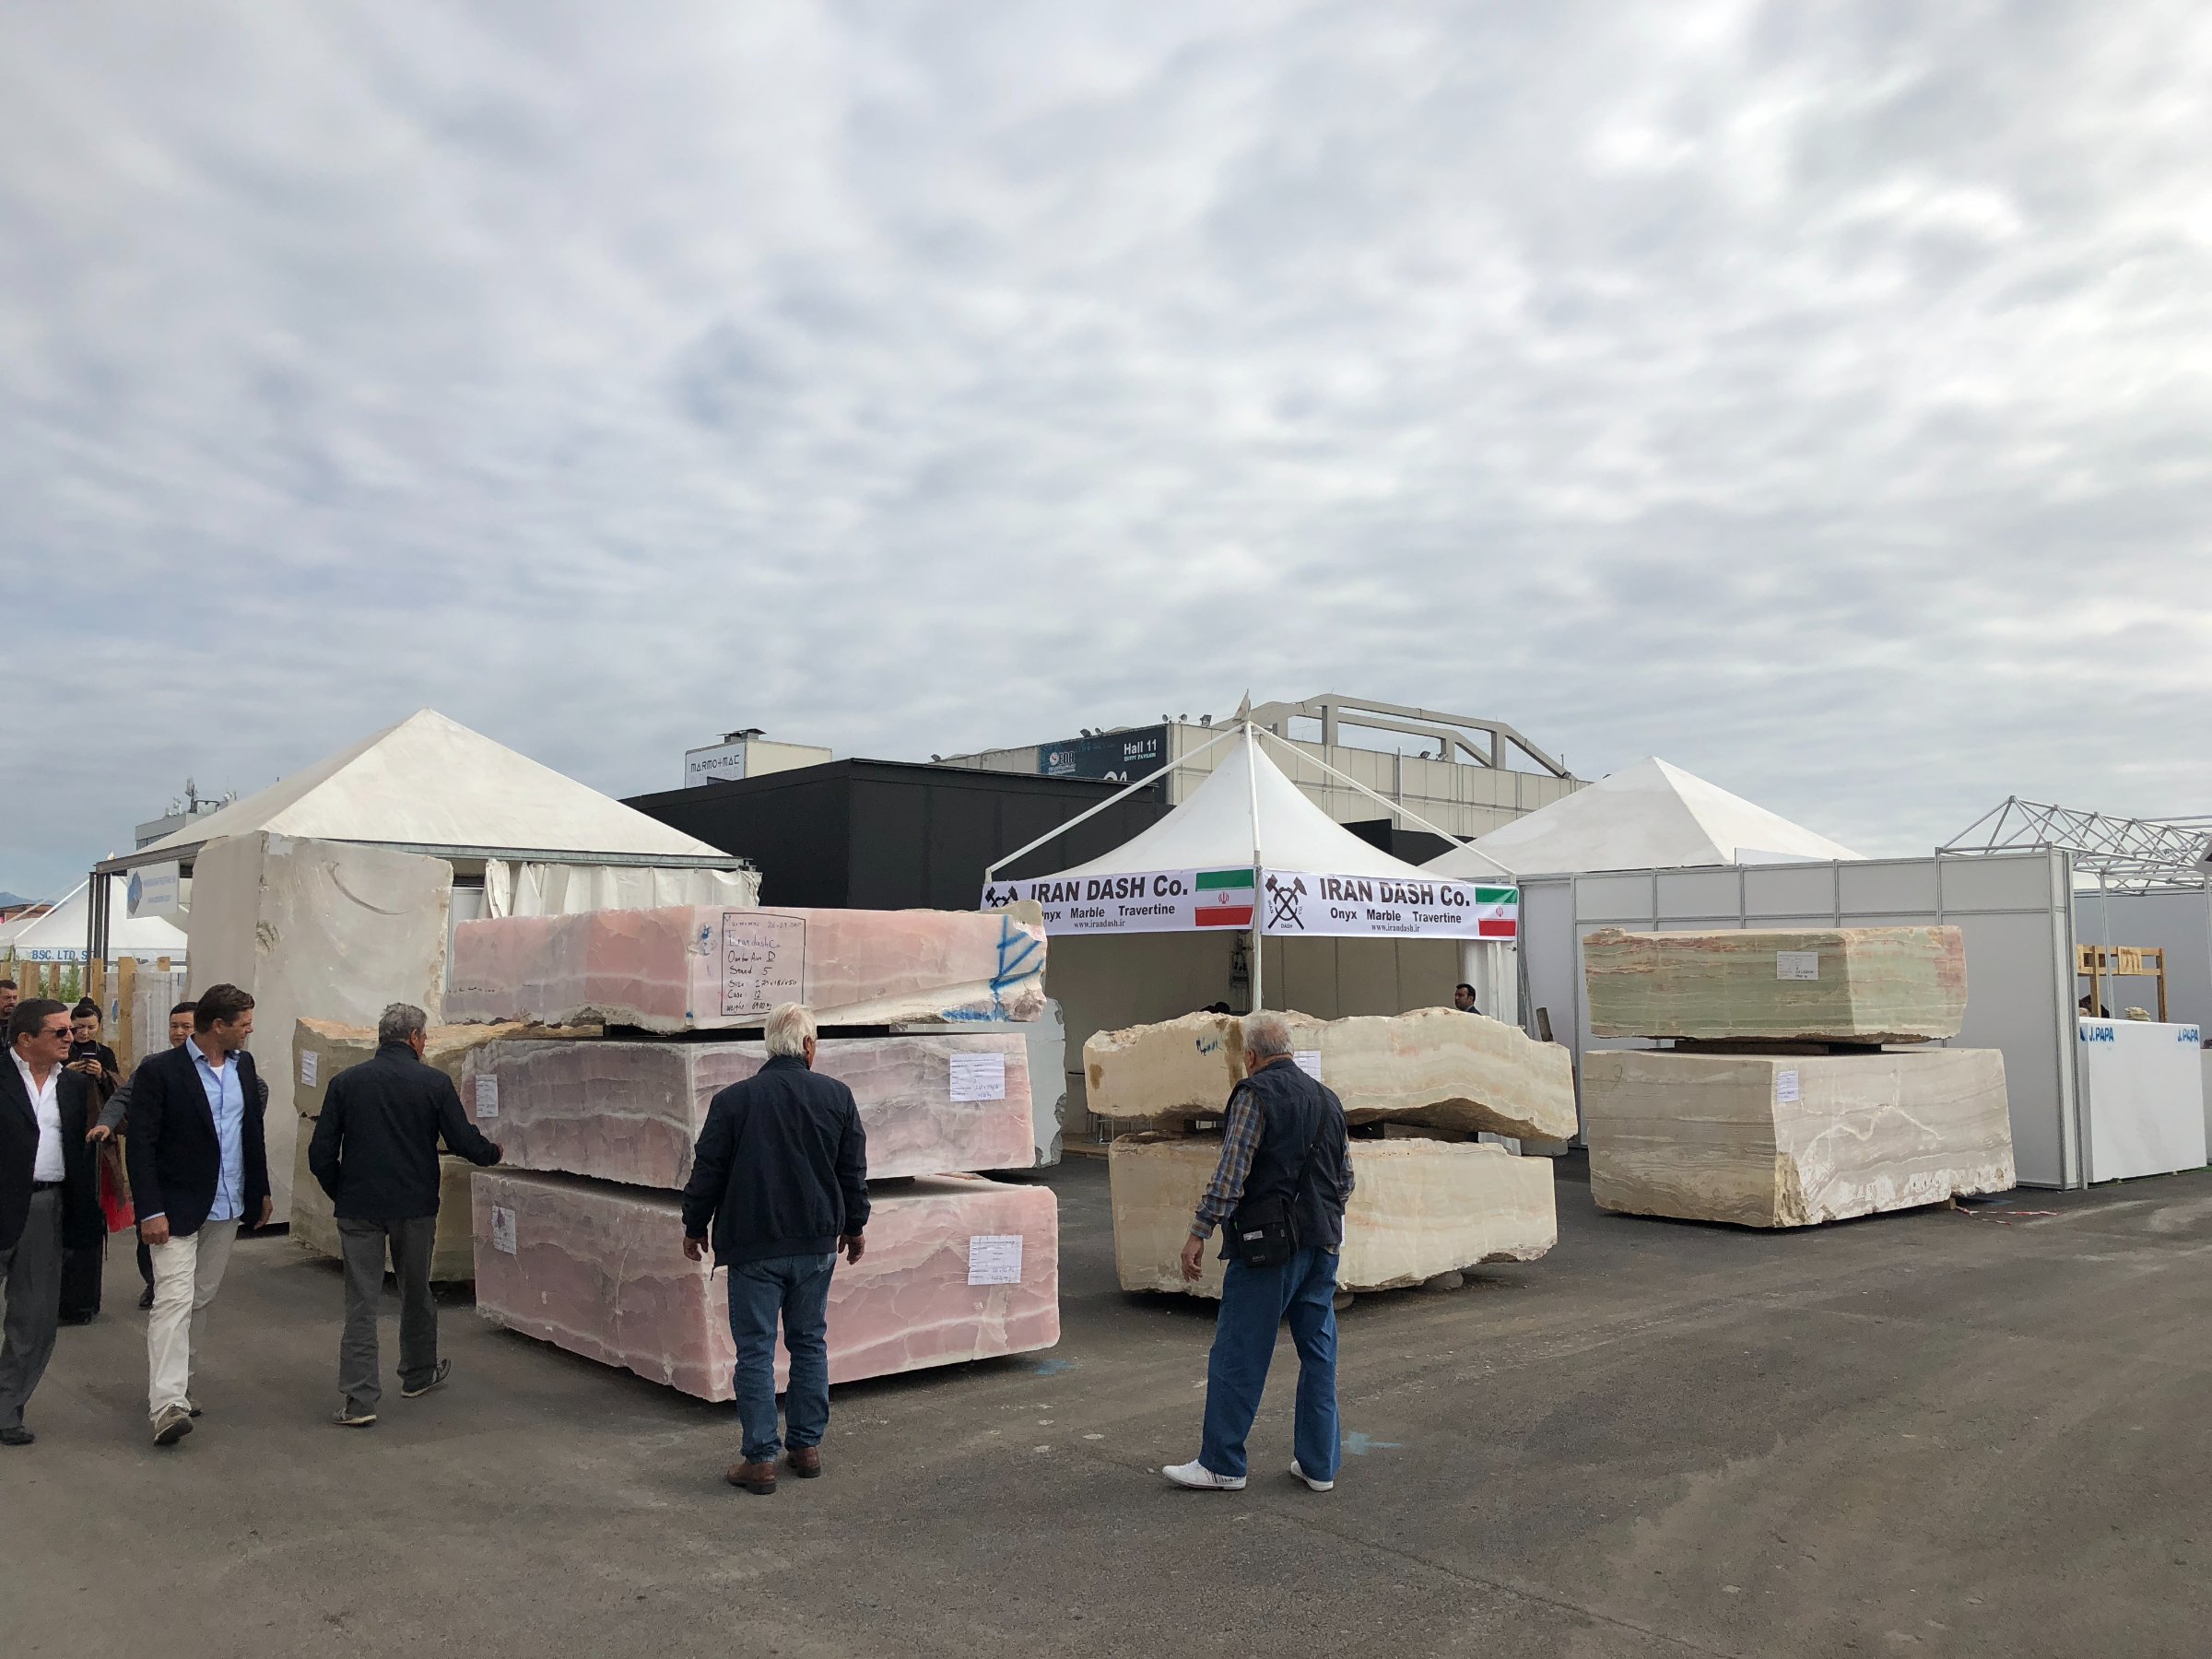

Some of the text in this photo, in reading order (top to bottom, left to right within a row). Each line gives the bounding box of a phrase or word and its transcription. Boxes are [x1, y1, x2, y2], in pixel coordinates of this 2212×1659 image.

[1124, 739, 1157, 755] Hall 11
[1030, 875, 1189, 903] IRAN DASH Co.
[1319, 877, 1471, 907] IRAN DASH Co.
[1041, 903, 1176, 922] nyx Marble Travertine
[1330, 907, 1462, 924] Onyx Marble Travertine
[1074, 920, 1126, 928] www.irandash.ir
[1371, 924, 1420, 933] www.irandash.ir
[766, 950, 775, 962] D
[729, 966, 773, 976] Stand 5
